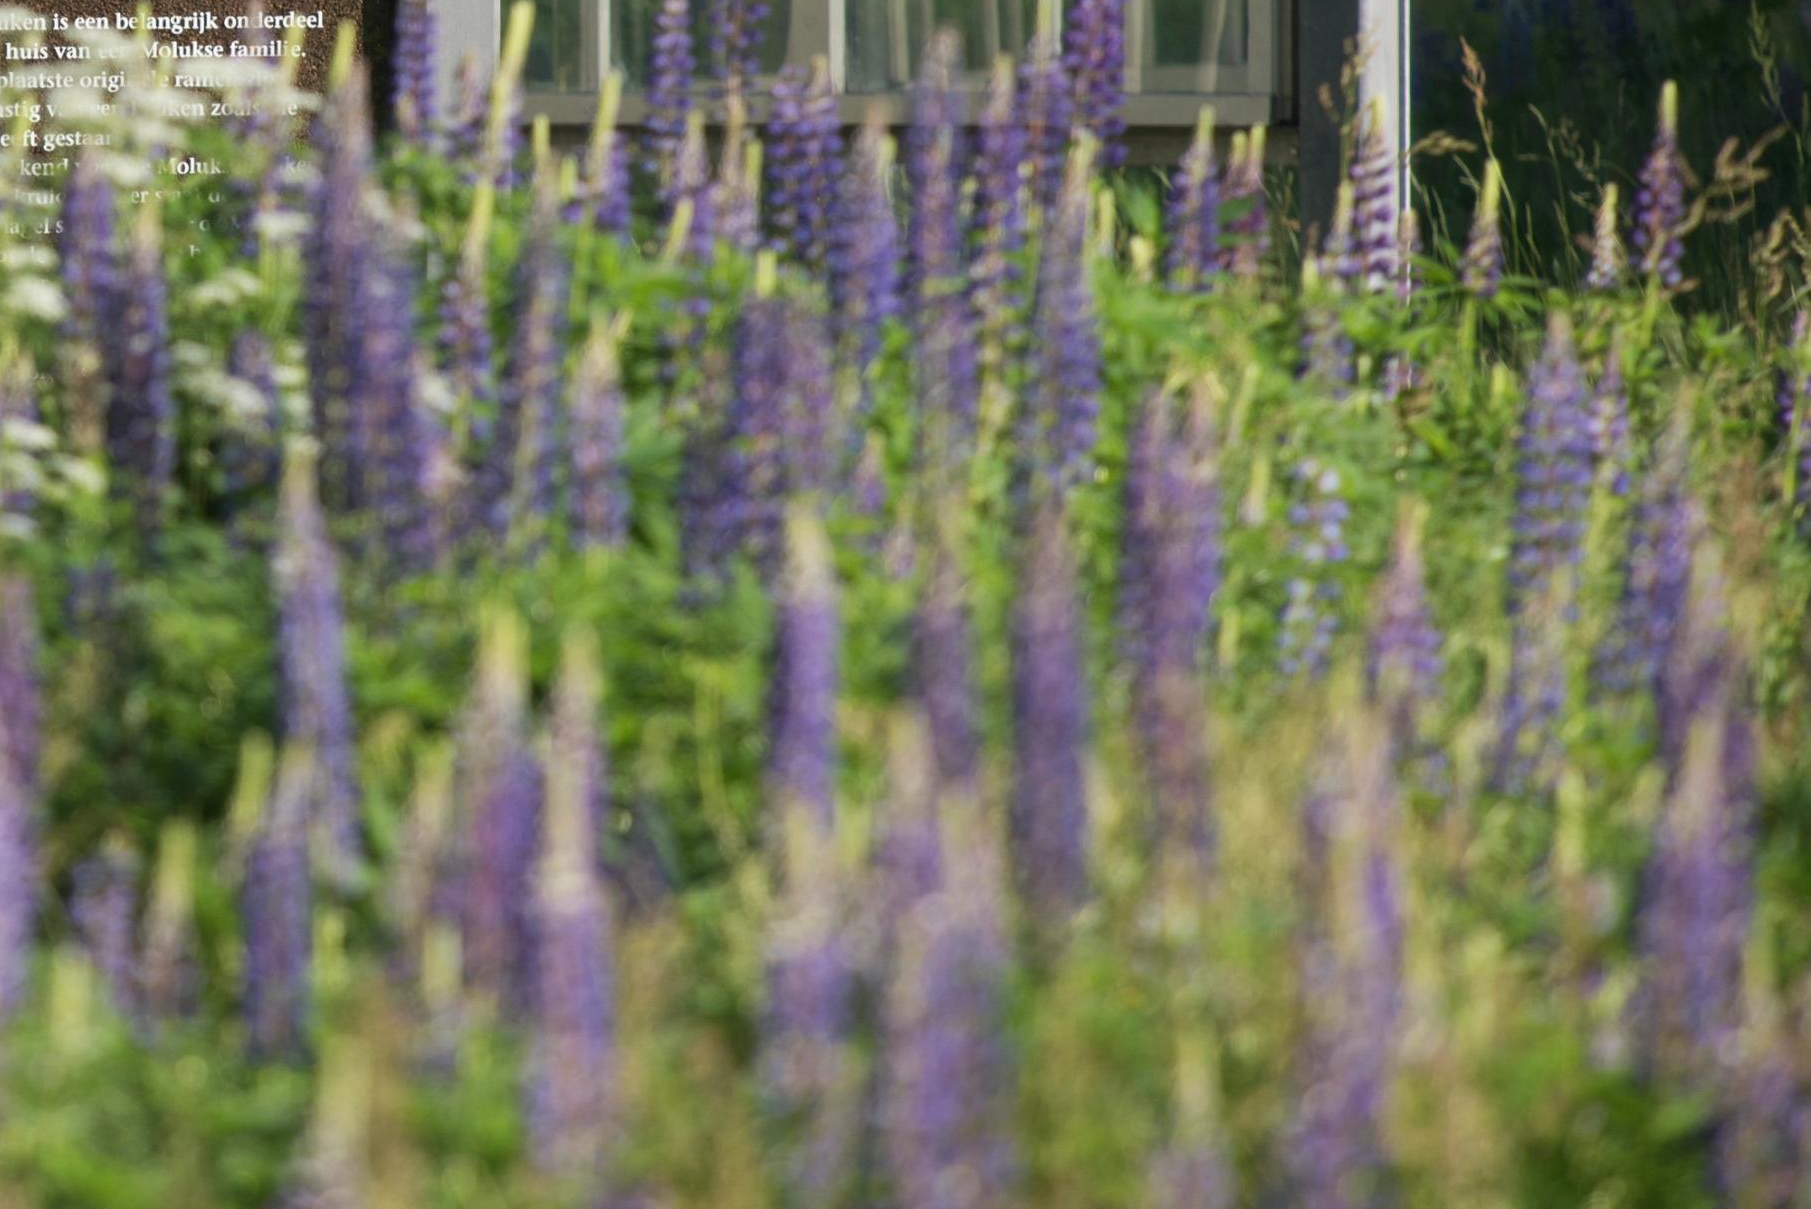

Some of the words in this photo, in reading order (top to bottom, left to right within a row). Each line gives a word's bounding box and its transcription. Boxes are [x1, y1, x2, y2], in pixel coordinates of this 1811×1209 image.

[53, 12, 69, 30] is
[74, 15, 110, 30] een
[116, 10, 218, 34] belangrijk
[5, 42, 49, 60] huis
[54, 44, 91, 59] van
